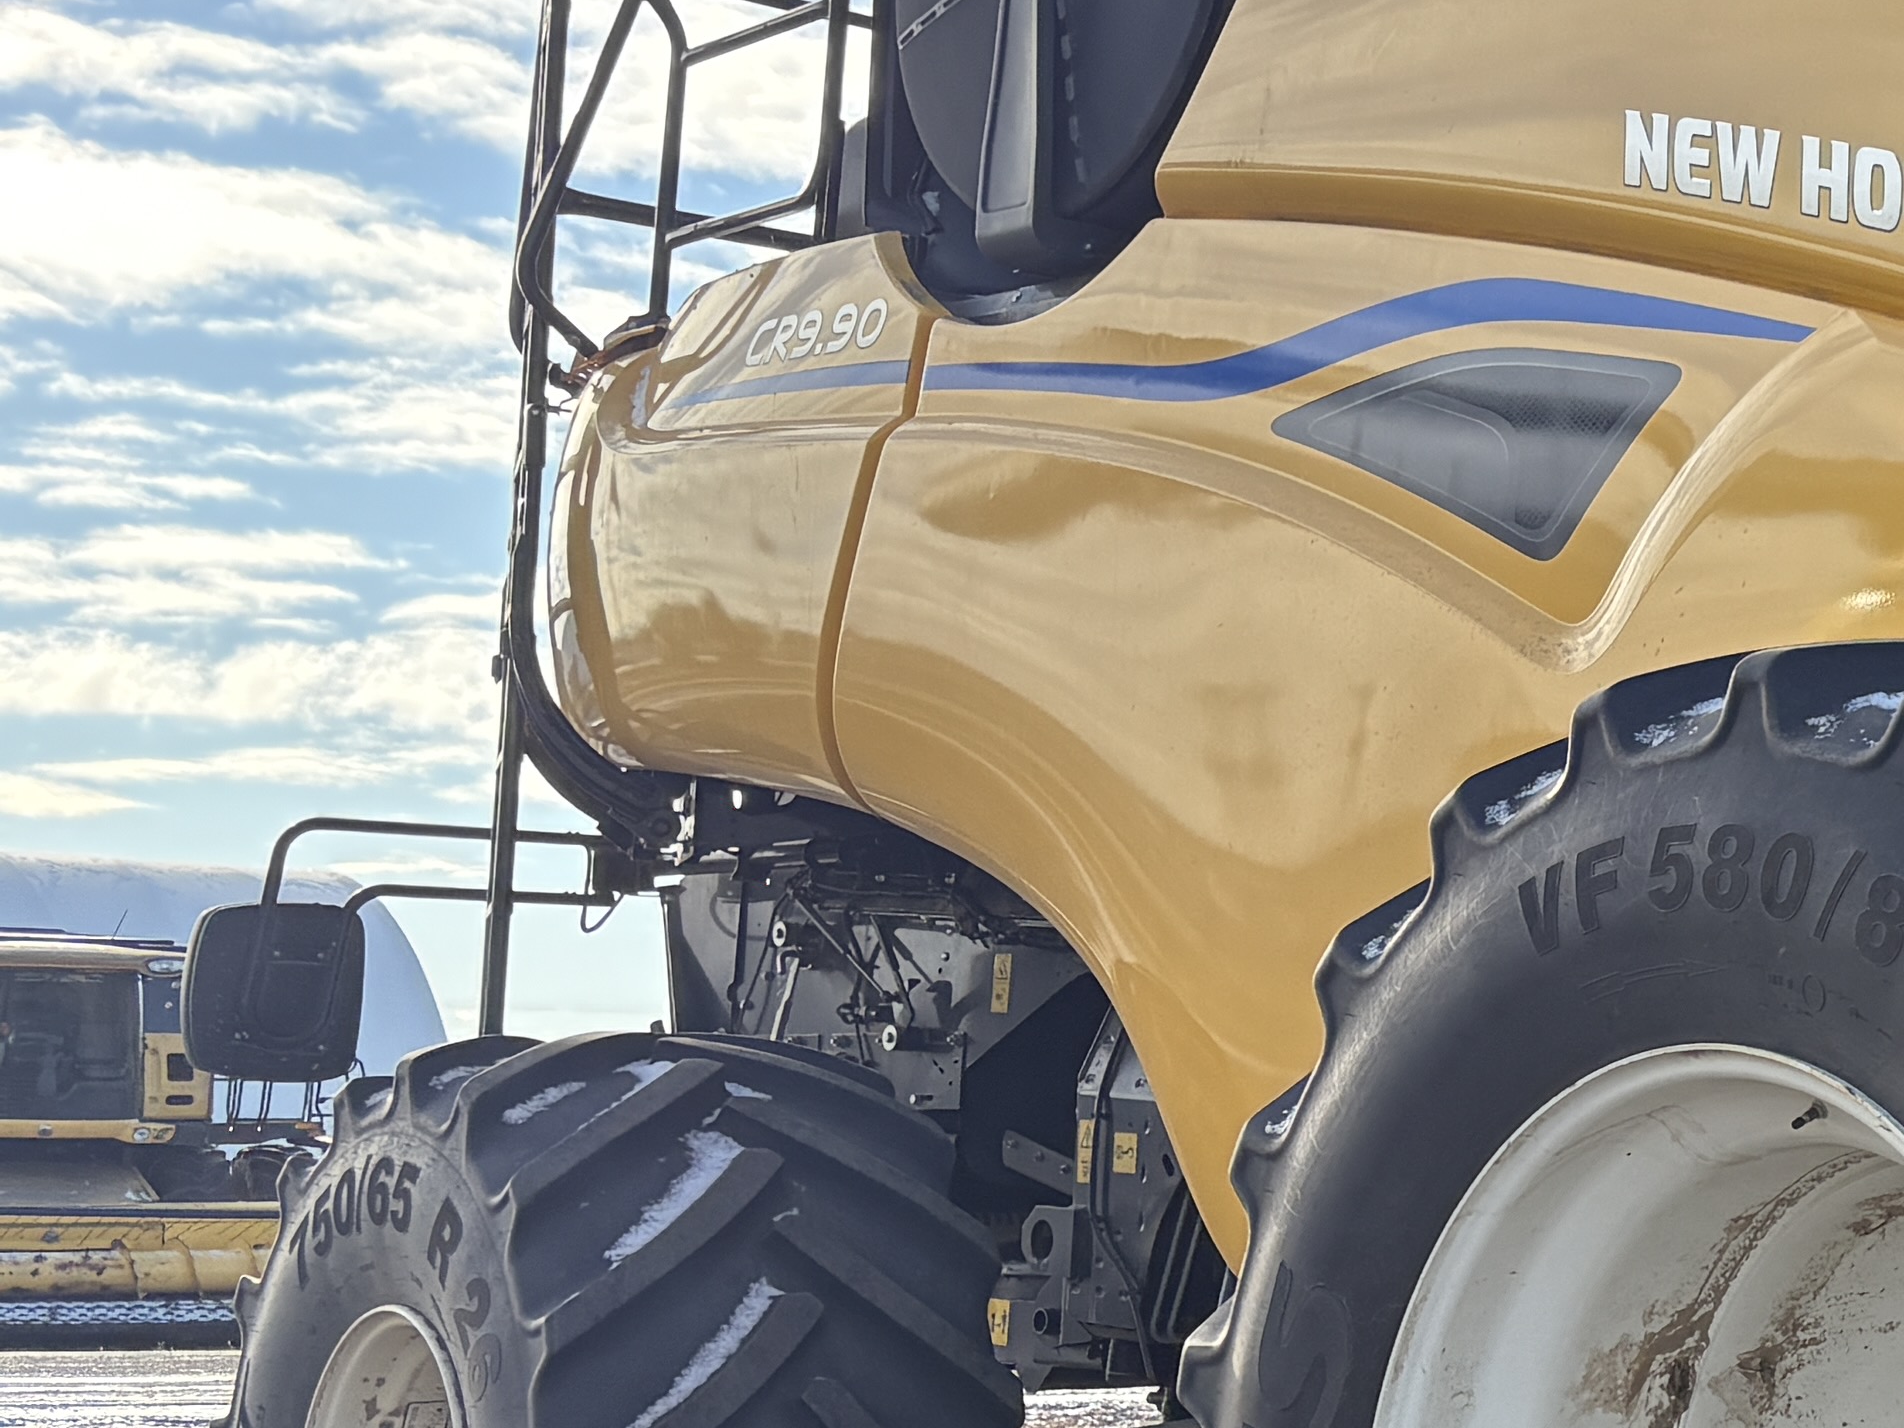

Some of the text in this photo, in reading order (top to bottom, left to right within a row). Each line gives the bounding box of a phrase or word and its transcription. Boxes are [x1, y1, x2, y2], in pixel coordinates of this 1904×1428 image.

[1623, 109, 1781, 209] NEW
[744, 297, 888, 367] CR9.90
[1517, 835, 1625, 956] VF
[289, 1153, 423, 1292] 750/65
[427, 1196, 463, 1291] R
